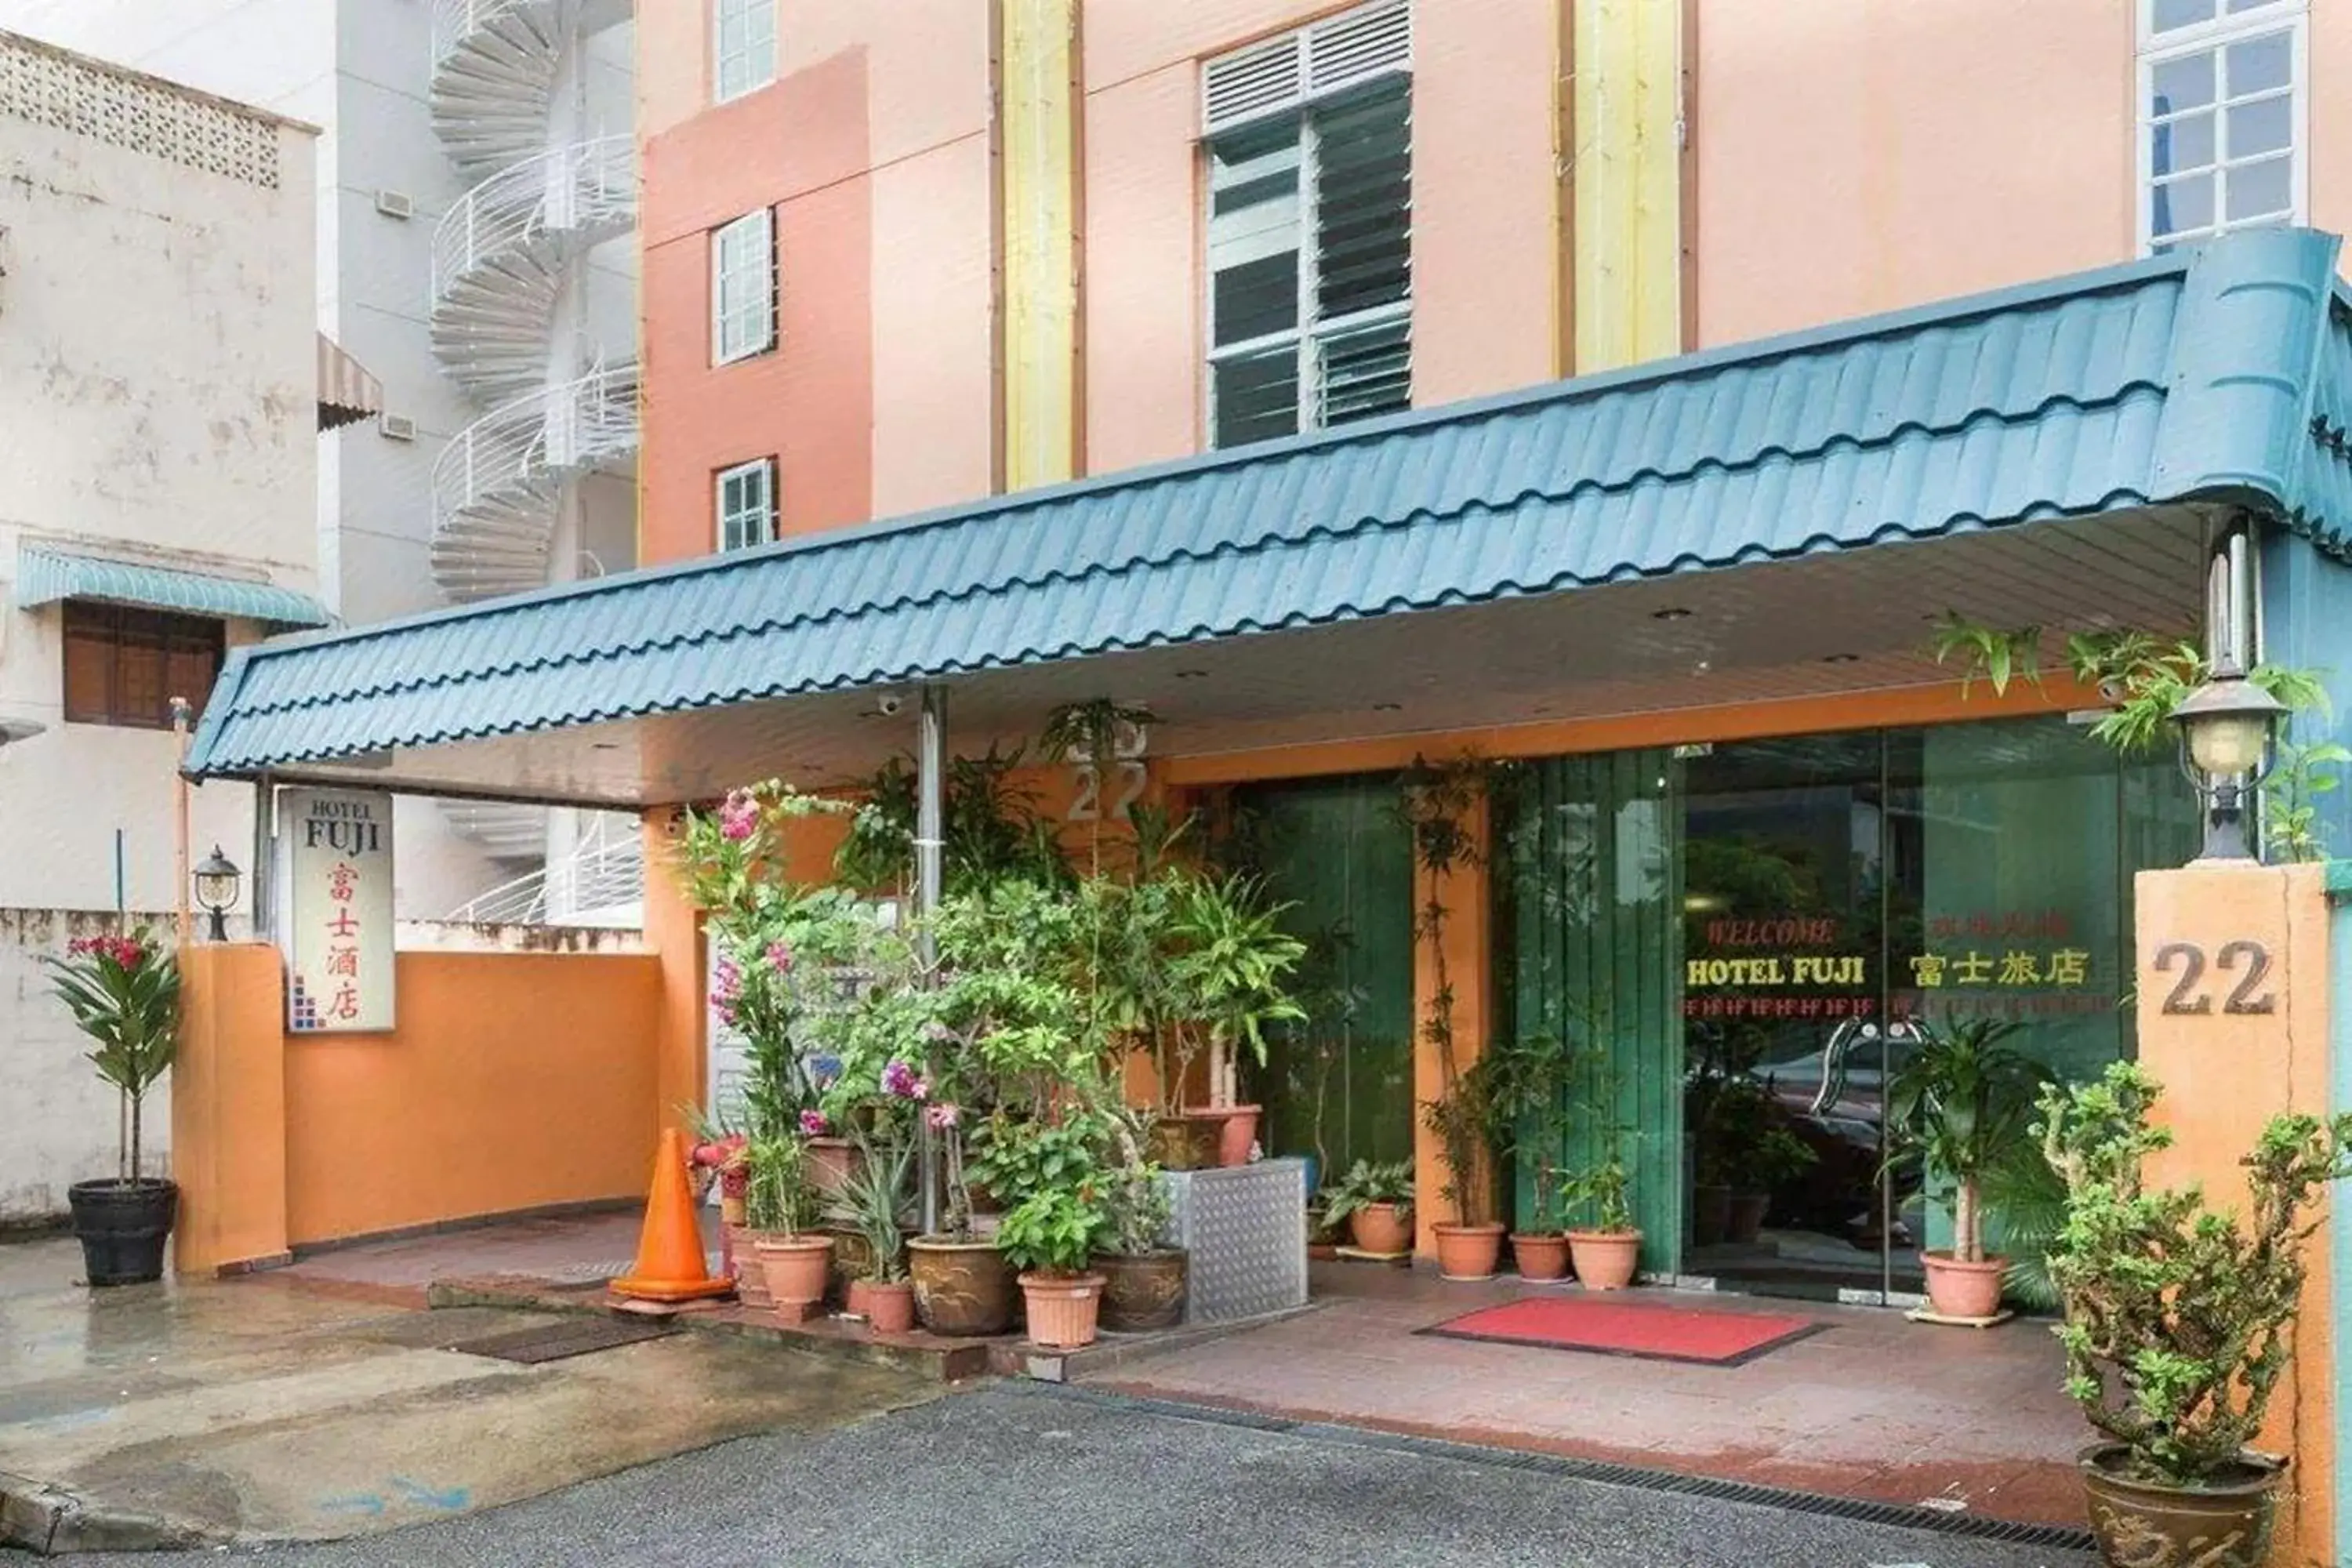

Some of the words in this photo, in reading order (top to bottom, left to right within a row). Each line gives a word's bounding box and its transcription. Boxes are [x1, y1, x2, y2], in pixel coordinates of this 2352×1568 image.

[312, 799, 372, 819] HOTEL
[305, 818, 380, 858] FUJI
[326, 862, 360, 1020] 富士酒店
[1708, 918, 1835, 946] WELCOME
[1687, 958, 1784, 986] HOTEL
[1792, 956, 1865, 985] FUJI
[1909, 947, 2089, 988] 富士旅店
[2154, 941, 2274, 1015] 22
